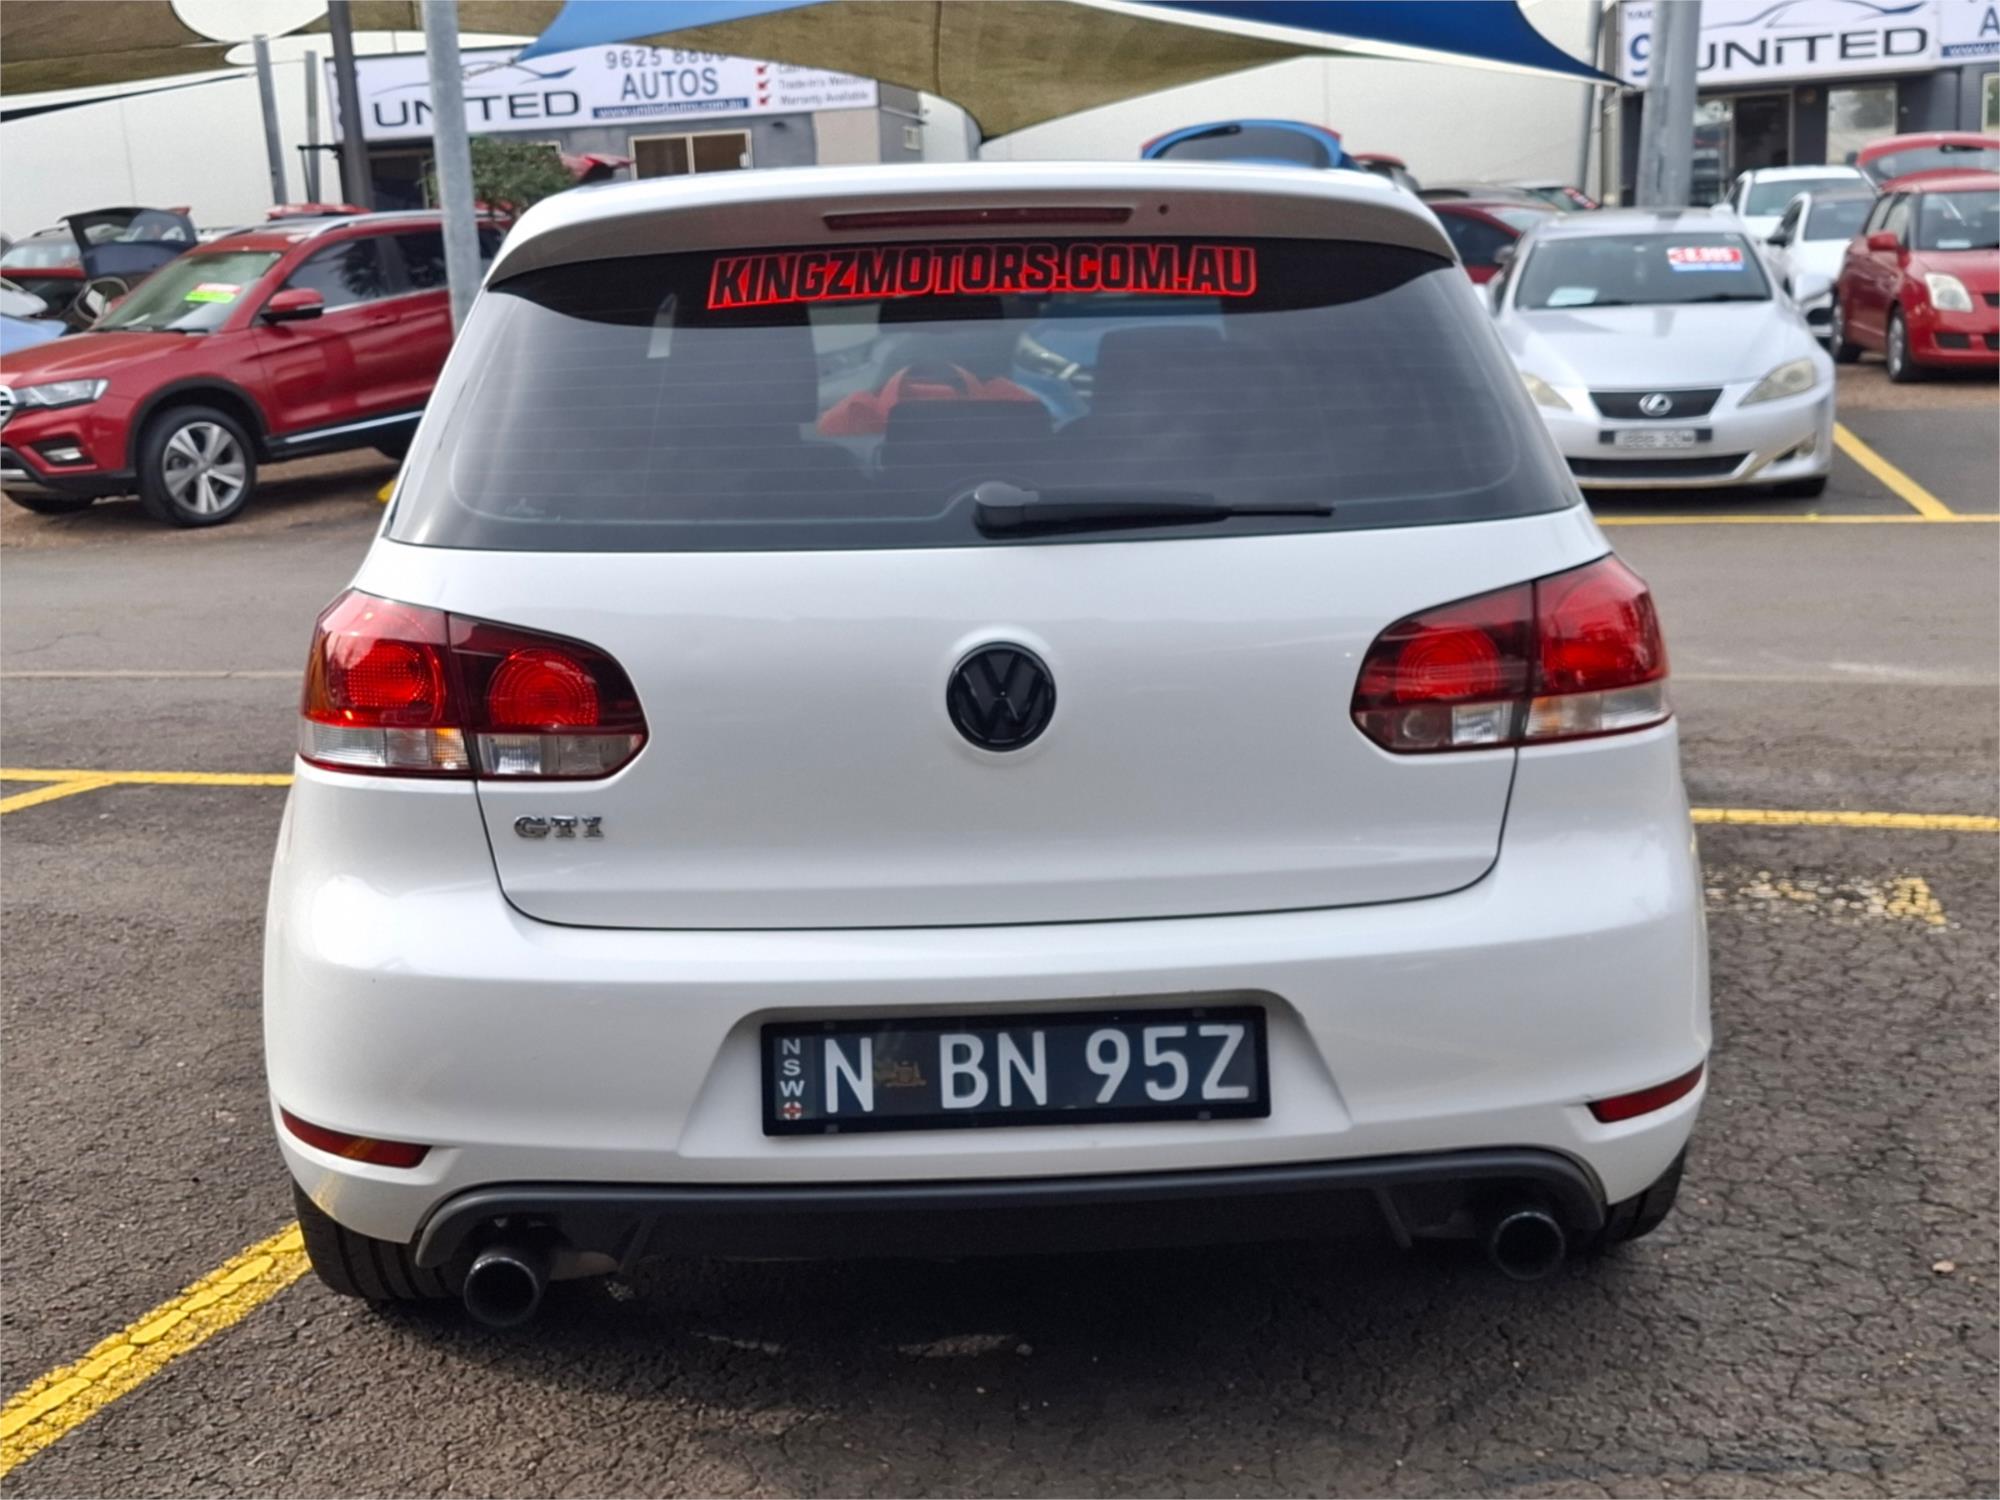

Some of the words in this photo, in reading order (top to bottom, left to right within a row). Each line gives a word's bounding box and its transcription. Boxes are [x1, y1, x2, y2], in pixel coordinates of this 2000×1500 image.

[605, 50, 662, 69] 9625
[621, 67, 719, 101] AUTOS
[374, 90, 580, 127] UNTED
[708, 244, 1257, 309] KINGZMOTORS.COM.AU
[514, 815, 604, 839] GTI
[824, 1037, 874, 1114] N
[939, 1031, 1048, 1109] BN
[1085, 1024, 1250, 1104] 95Z
